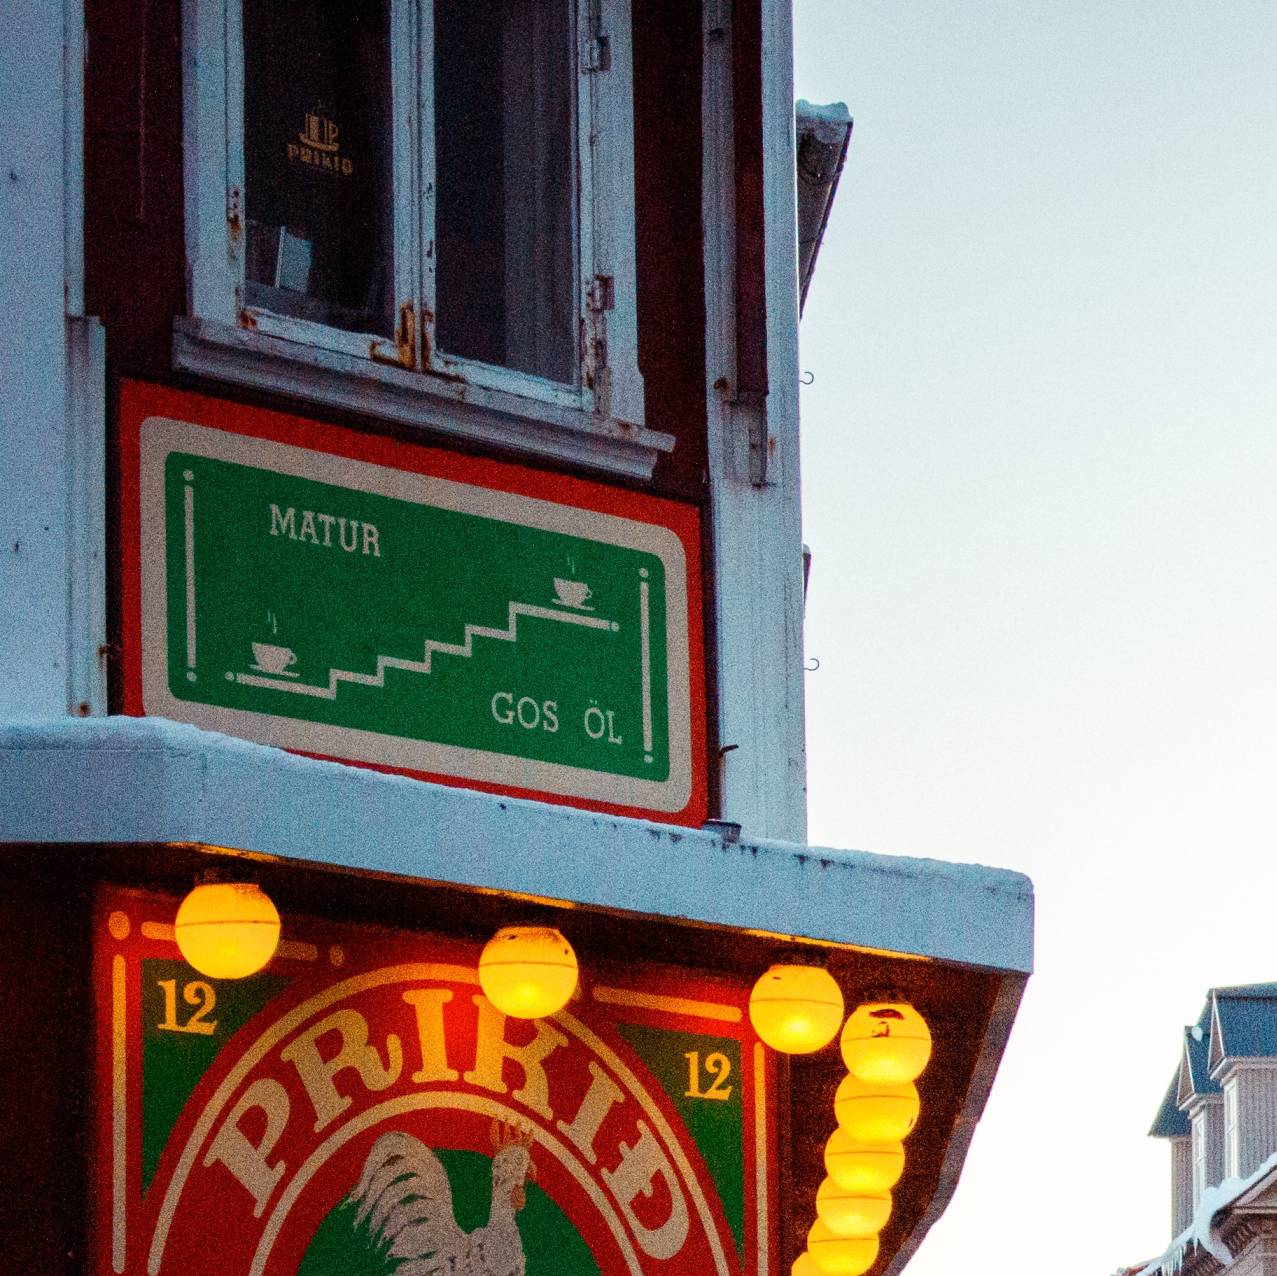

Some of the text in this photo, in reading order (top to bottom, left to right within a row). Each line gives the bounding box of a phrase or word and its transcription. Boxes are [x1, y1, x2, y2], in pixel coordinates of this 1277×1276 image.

[269, 503, 381, 557] MATUR
[491, 692, 623, 744] GOS ÖL
[156, 978, 218, 1035] 12
[683, 1050, 733, 1101] 12
[203, 988, 692, 1260] PRIKIÐ
